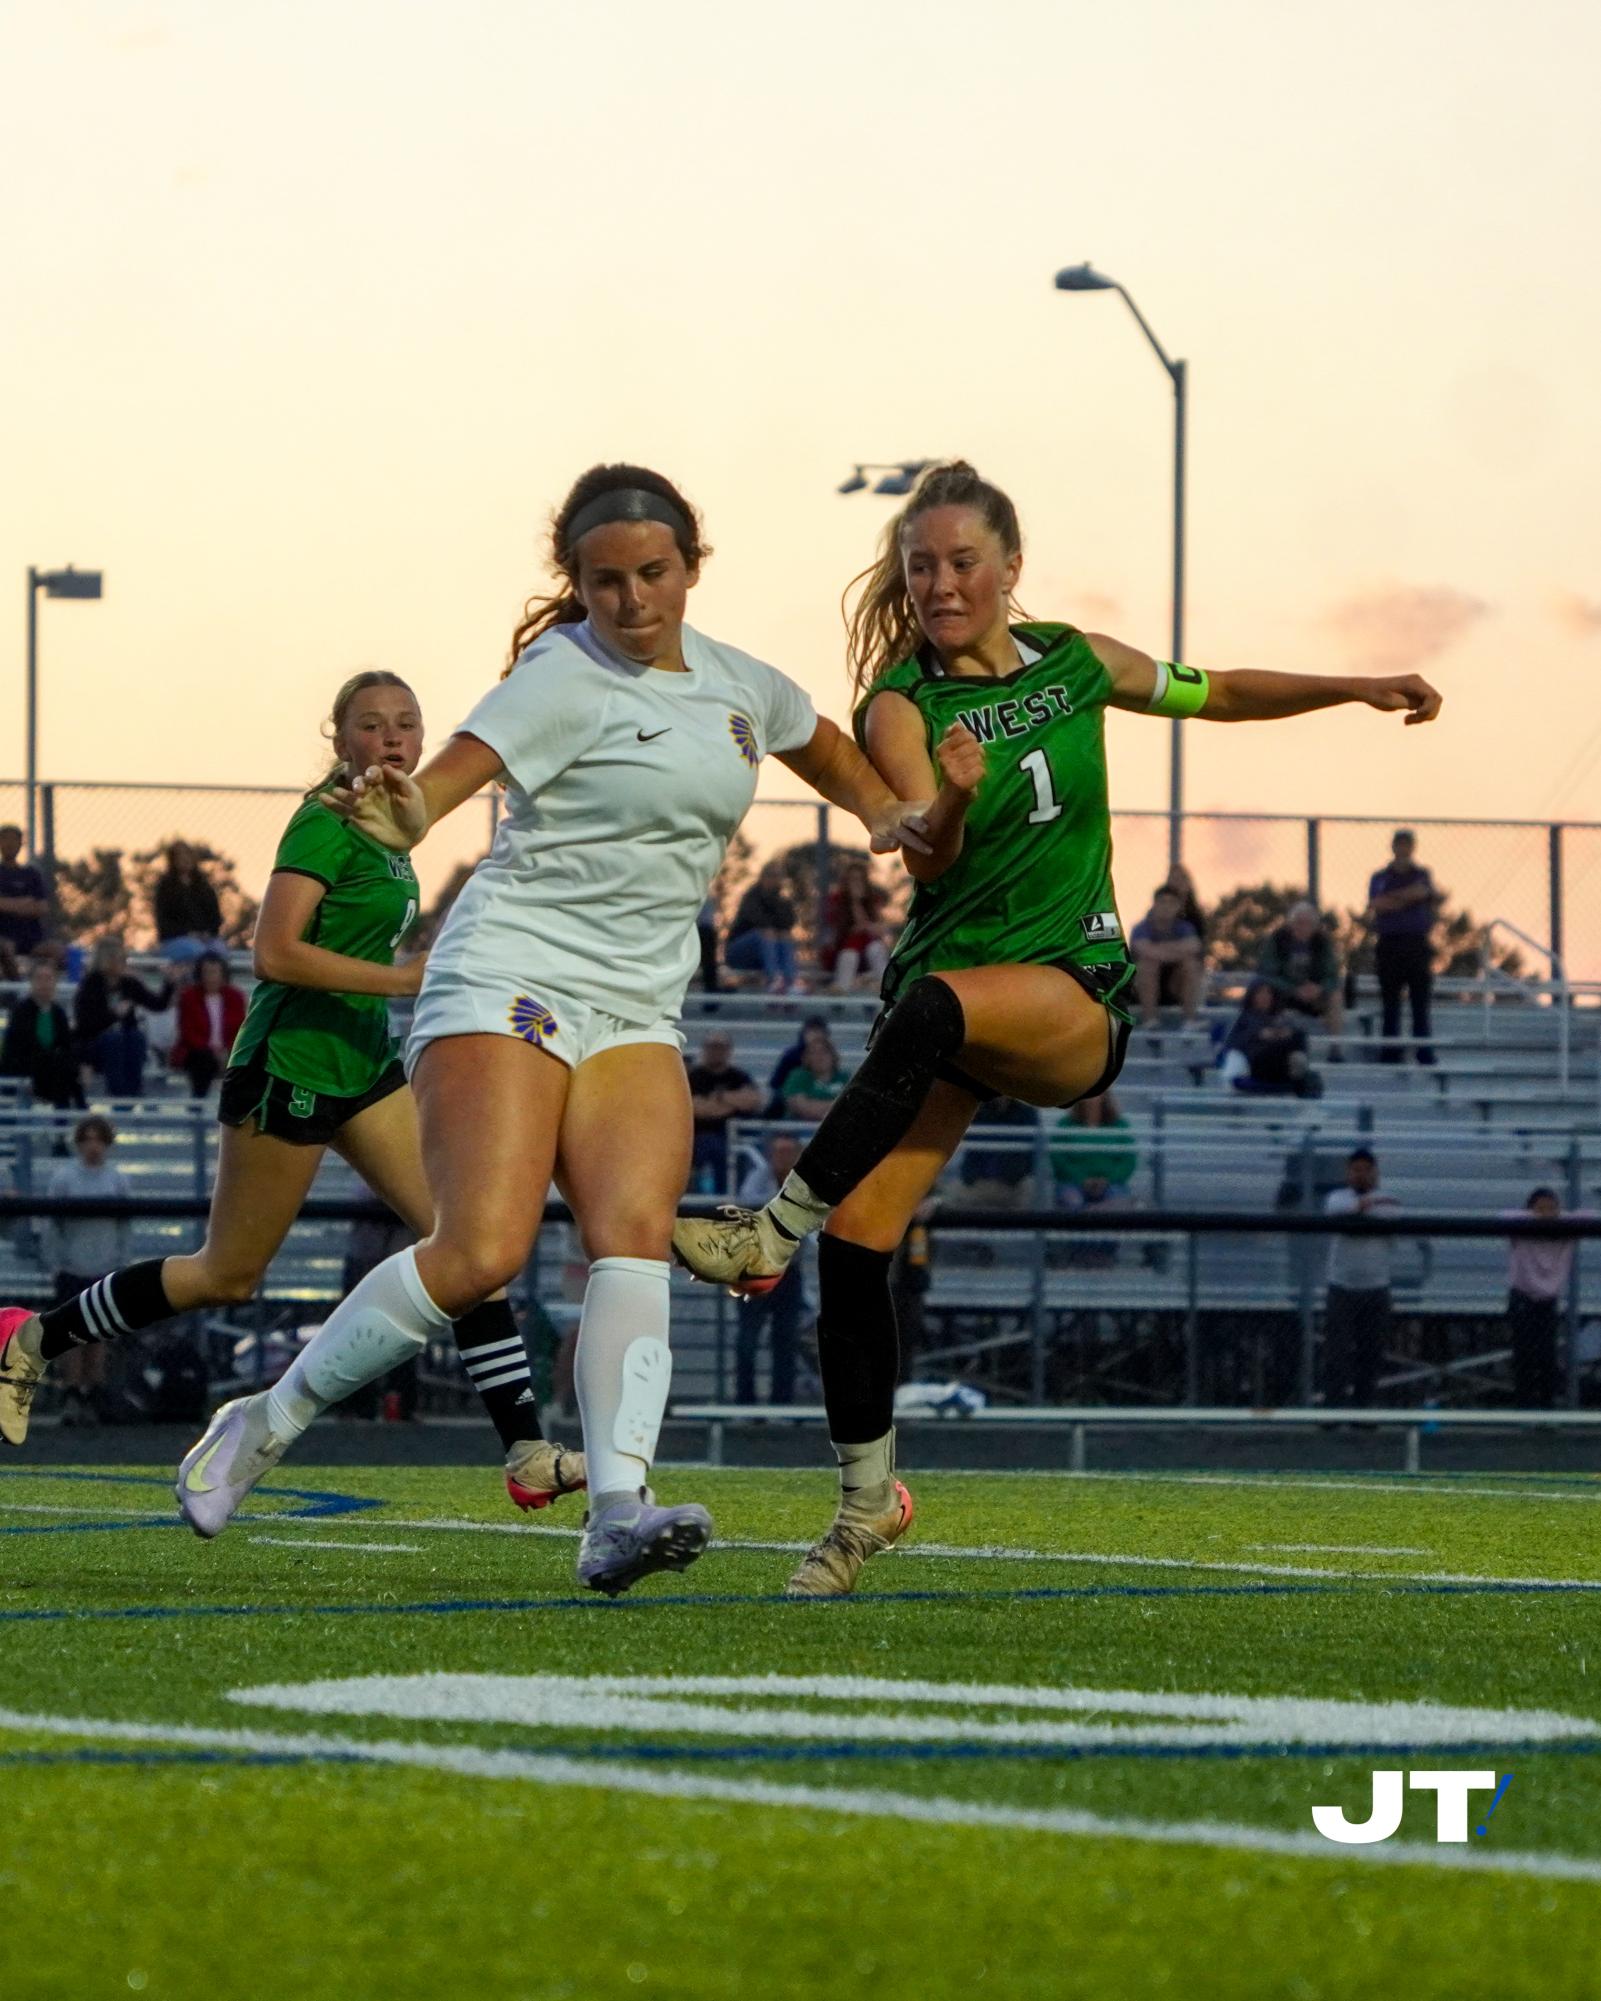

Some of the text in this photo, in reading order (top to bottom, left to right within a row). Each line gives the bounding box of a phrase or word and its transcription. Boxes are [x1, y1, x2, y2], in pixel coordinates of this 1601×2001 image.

[958, 685, 1073, 744] WEST
[1018, 747, 1063, 825] 1
[389, 897, 416, 948] 9
[288, 1085, 316, 1118] 9
